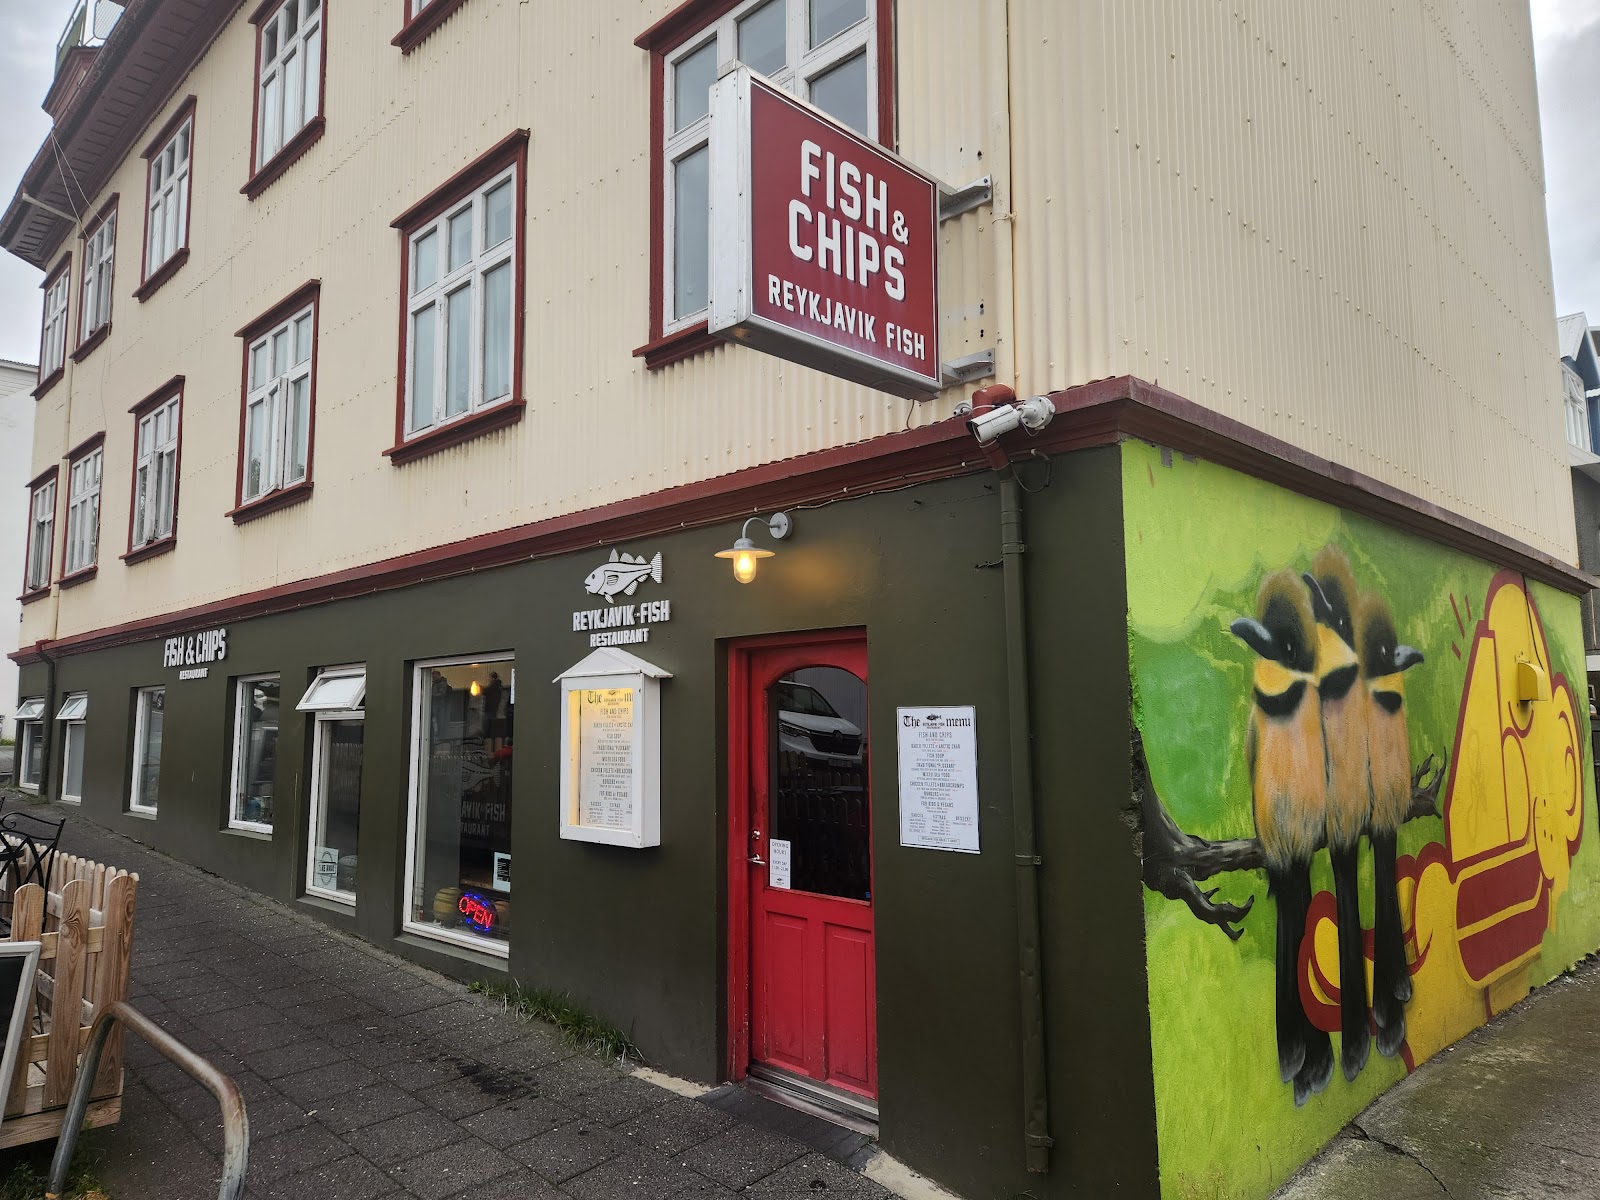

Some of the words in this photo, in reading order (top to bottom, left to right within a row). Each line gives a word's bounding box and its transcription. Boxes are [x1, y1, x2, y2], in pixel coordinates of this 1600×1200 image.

[801, 139, 888, 236] FISH
[892, 210, 909, 245] &
[788, 199, 906, 301] CHIPS
[768, 273, 876, 343] REYKJAVIK
[886, 322, 925, 361] FISH
[163, 636, 185, 668] FISH
[185, 636, 196, 665] &
[196, 628, 226, 664] CHIPS
[590, 627, 649, 647] RESTAURANT
[587, 690, 603, 705] The
[903, 715, 921, 729] The
[945, 717, 972, 727] menu
[939, 731, 953, 739] CHIPS
[485, 802, 506, 822] FISH
[458, 896, 493, 929] OPEN
